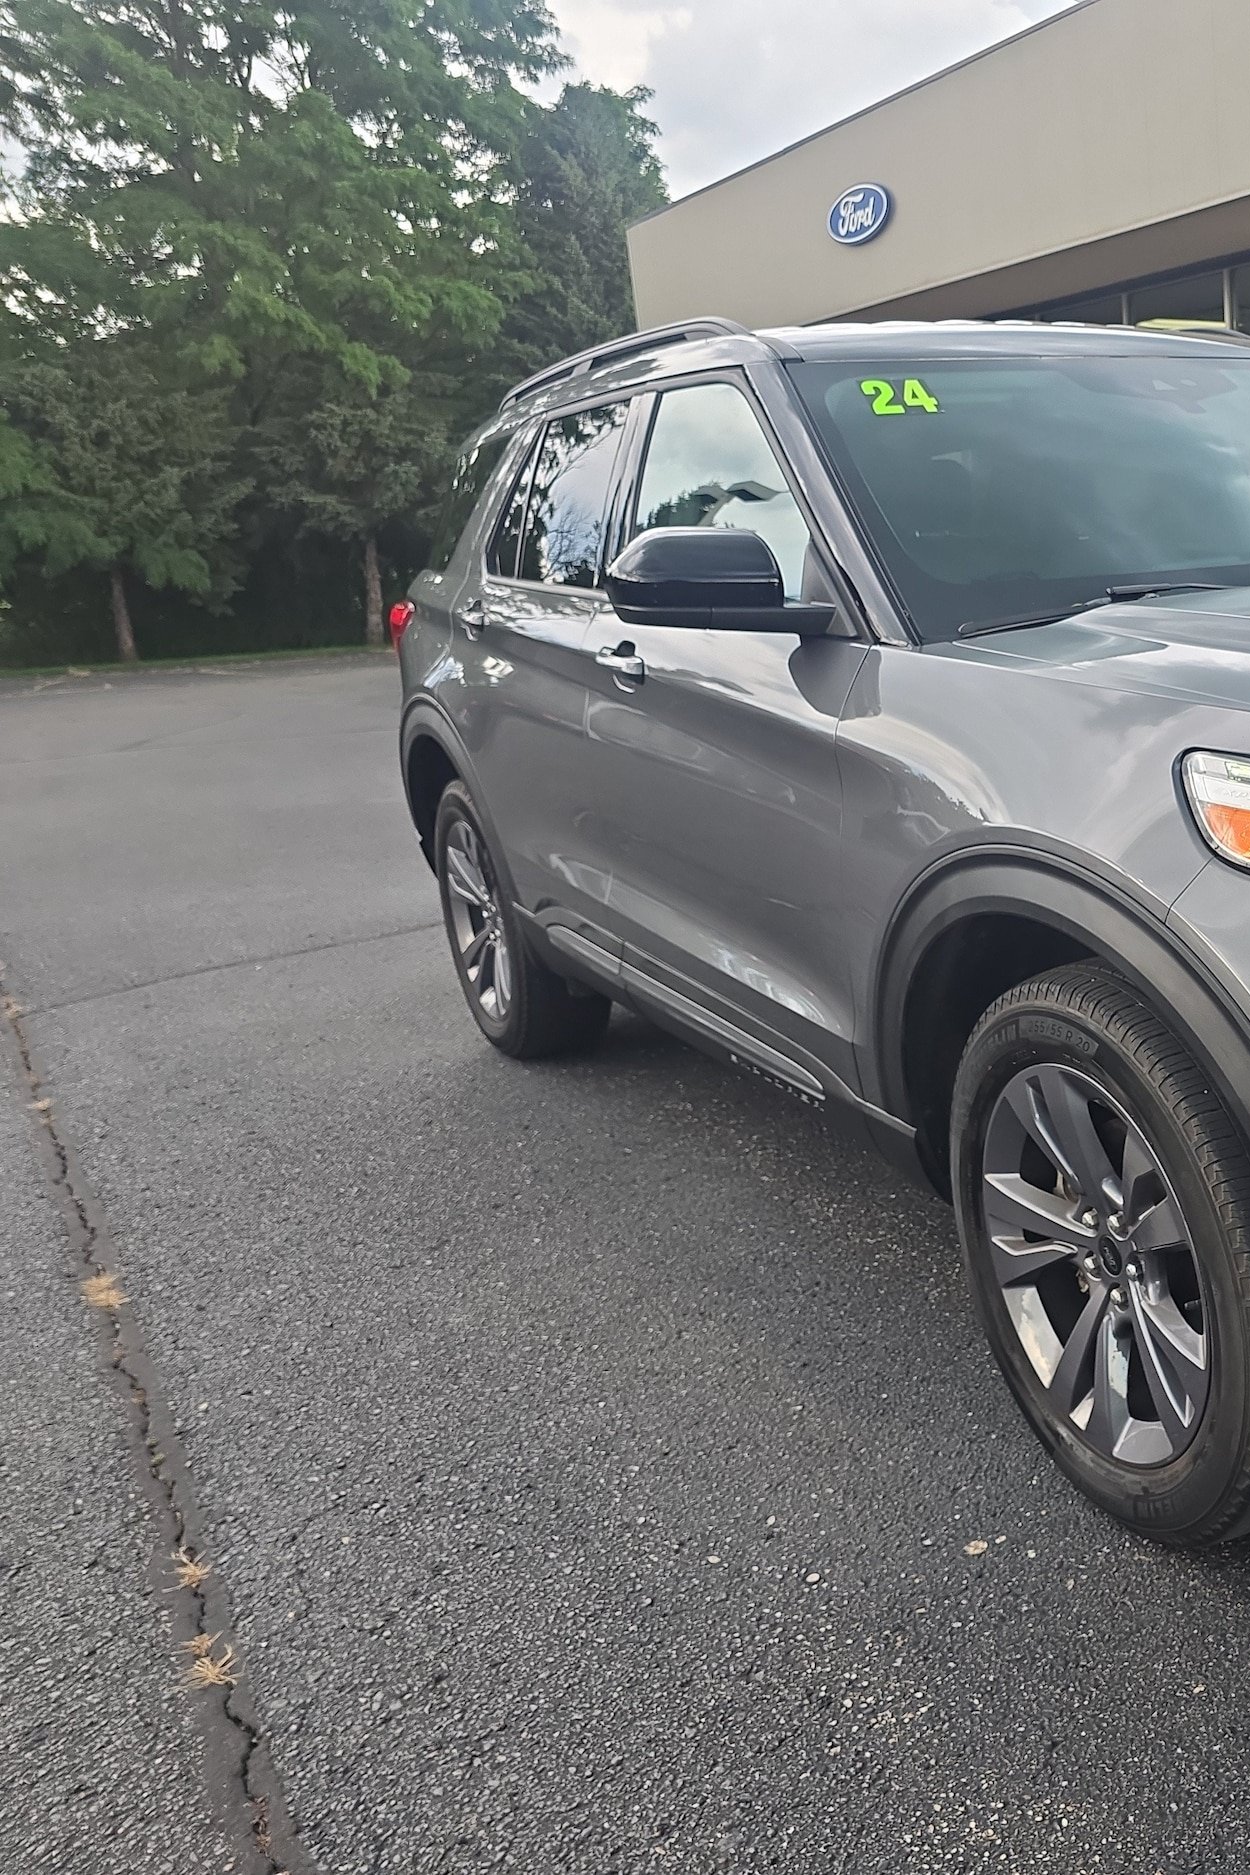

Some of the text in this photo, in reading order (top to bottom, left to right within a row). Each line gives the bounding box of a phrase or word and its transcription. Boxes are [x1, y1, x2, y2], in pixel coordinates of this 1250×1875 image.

[859, 378, 939, 416] 24
[1064, 1030, 1073, 1042] R
[1075, 1036, 1091, 1052] 20
